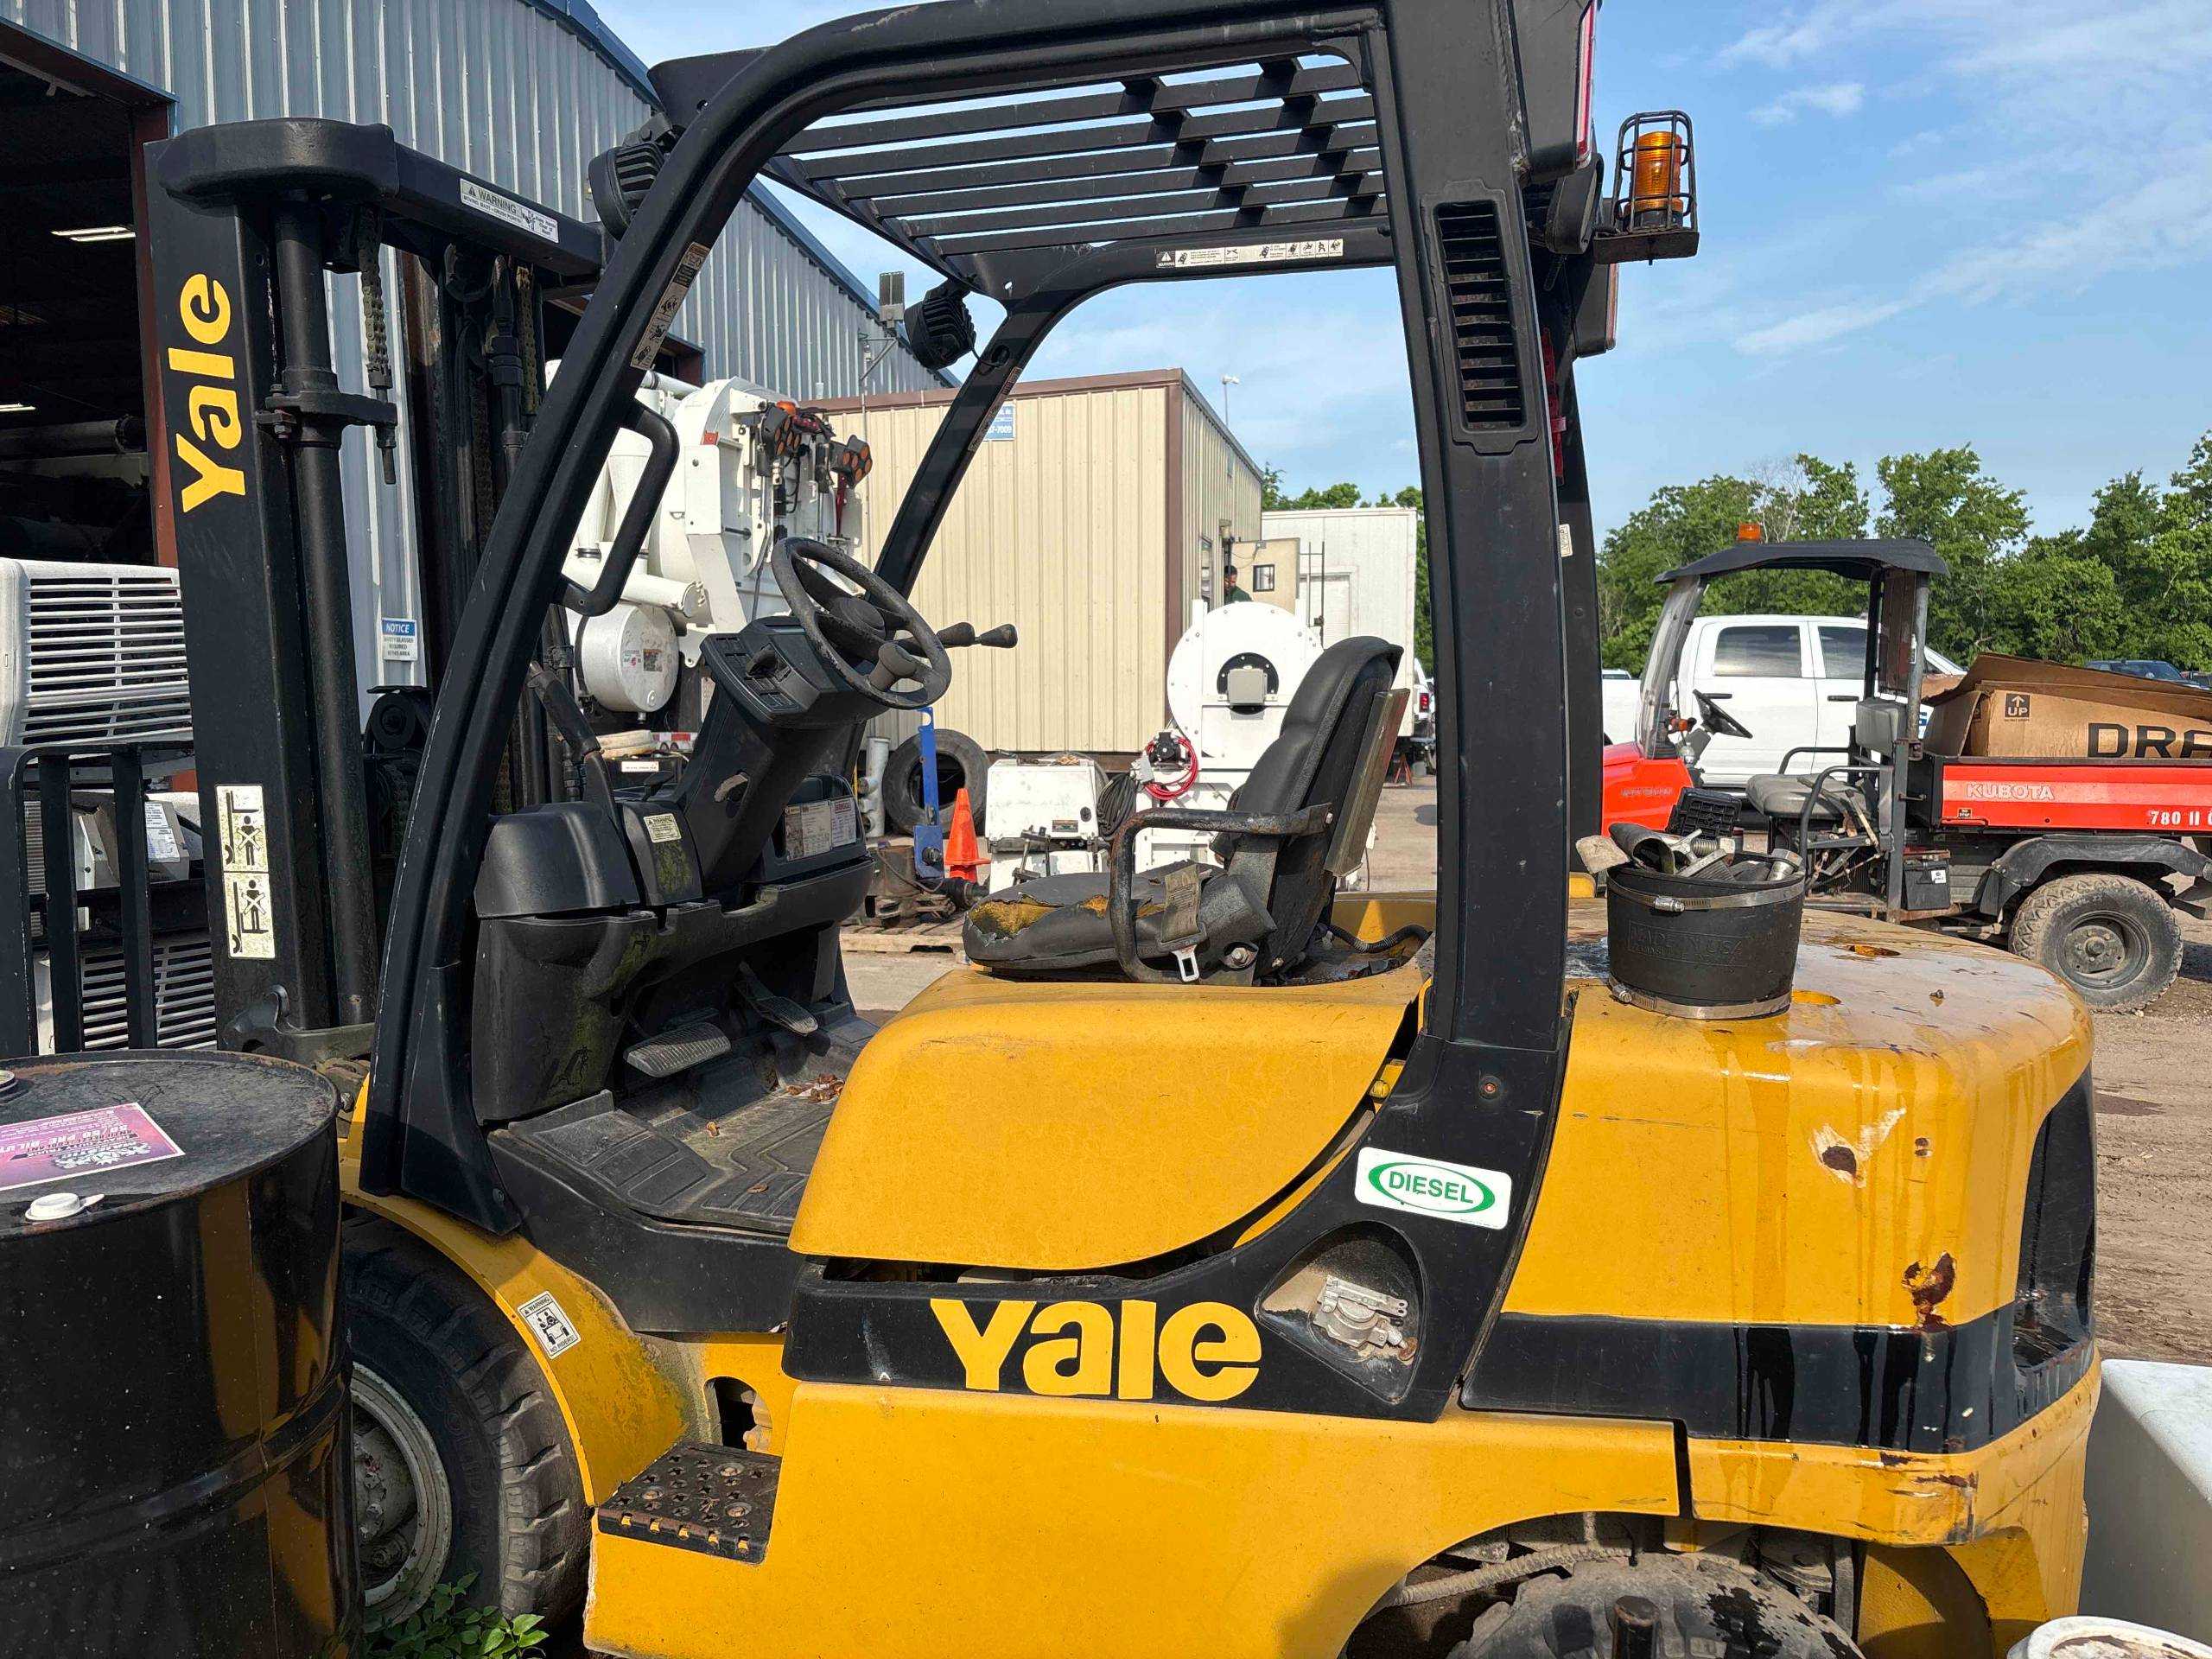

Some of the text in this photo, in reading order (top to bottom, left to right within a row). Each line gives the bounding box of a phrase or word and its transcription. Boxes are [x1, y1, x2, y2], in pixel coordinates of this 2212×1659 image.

[479, 188, 517, 214] WARNING
[168, 273, 245, 513] Yale
[386, 623, 410, 633] NOTICE
[2007, 706, 2028, 716] UP
[1966, 782, 2055, 801] KUBOTA
[2150, 810, 2181, 826] 780
[1389, 1171, 1474, 1205] DIESEL
[930, 1298, 1262, 1402] Yale
